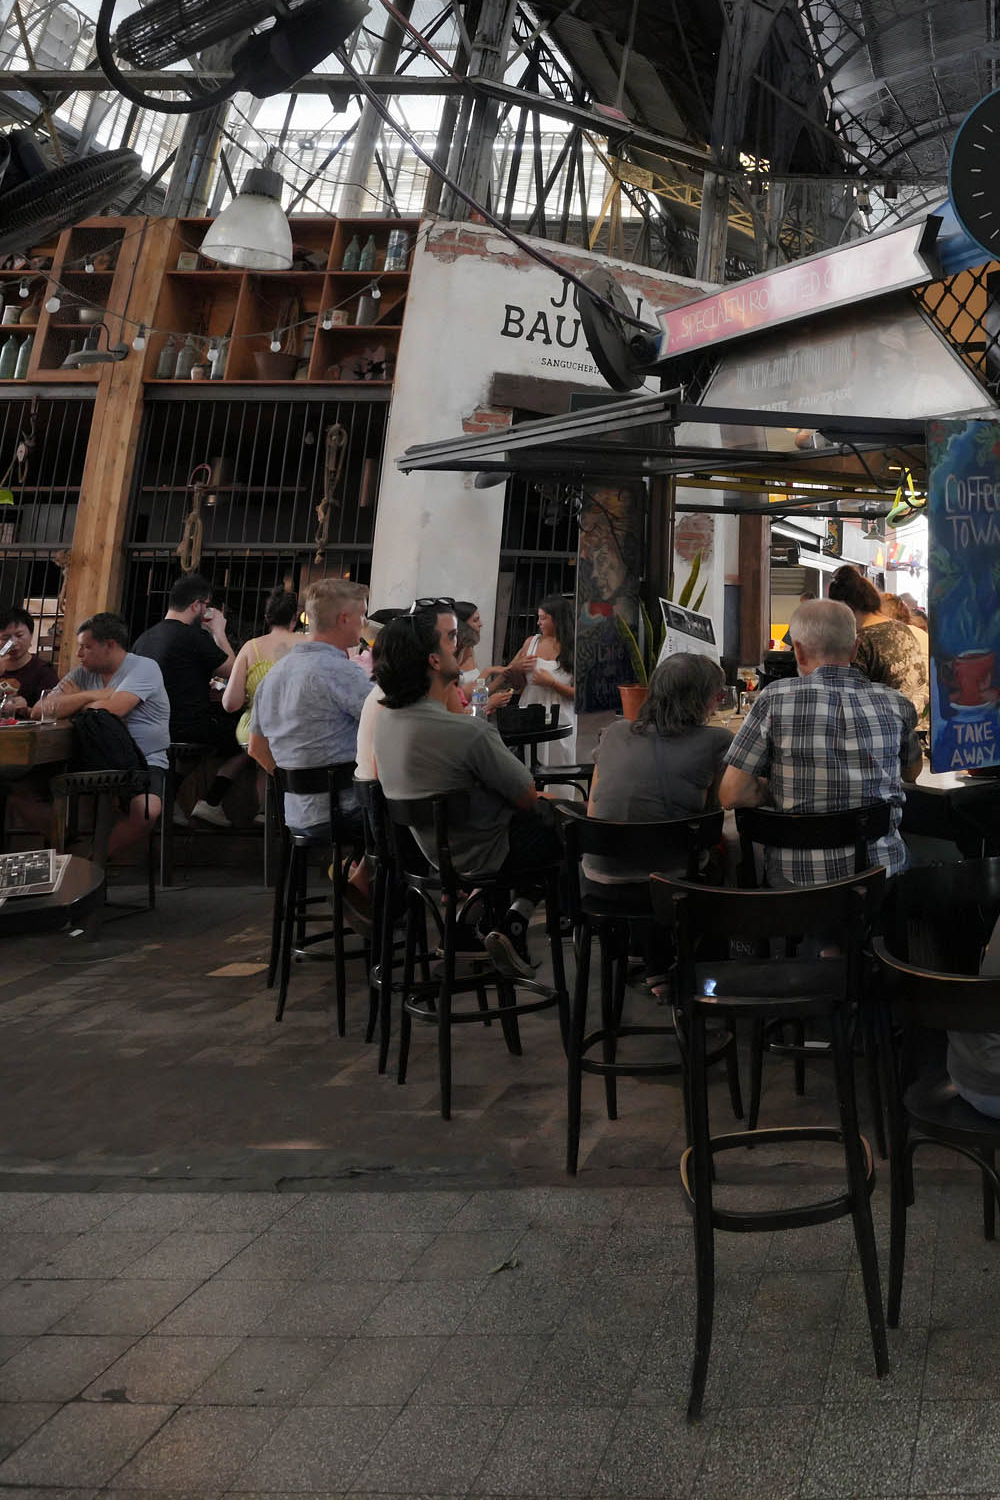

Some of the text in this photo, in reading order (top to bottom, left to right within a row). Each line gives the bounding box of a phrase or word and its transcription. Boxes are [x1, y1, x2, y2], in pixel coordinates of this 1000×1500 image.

[681, 294, 746, 342] SPECIALTY
[953, 720, 995, 745] TAKE
[950, 743, 997, 768] AWAY
